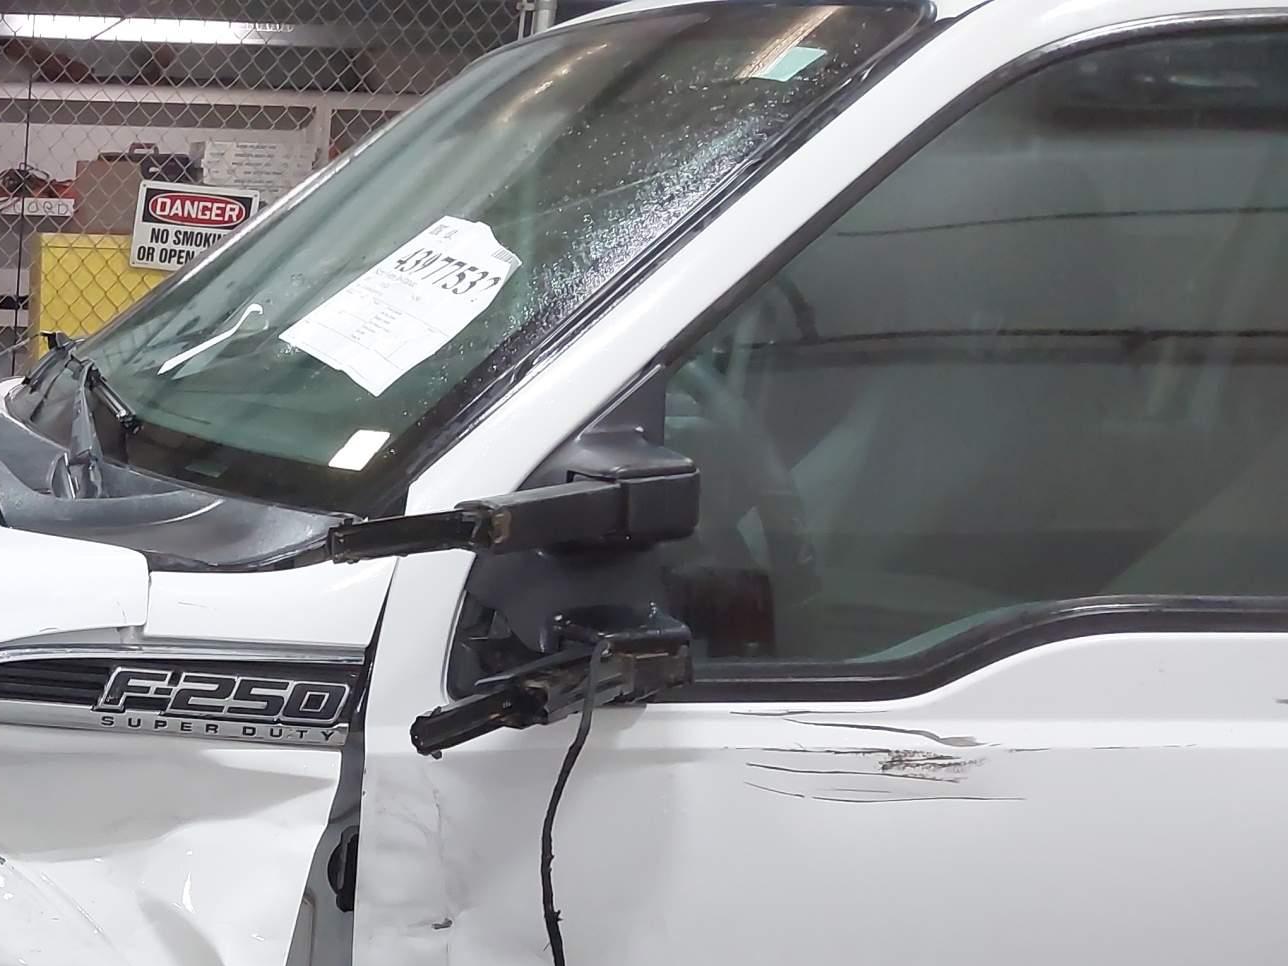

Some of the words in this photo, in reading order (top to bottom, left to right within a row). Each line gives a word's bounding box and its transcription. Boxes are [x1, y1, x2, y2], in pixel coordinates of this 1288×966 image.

[155, 197, 240, 222] DANGER
[150, 227, 170, 245] NO
[136, 245, 155, 262] OR
[158, 248, 195, 265] OPEN
[93, 665, 350, 725] F-250
[101, 715, 220, 736] SUPER
[241, 725, 334, 741] DUTY
